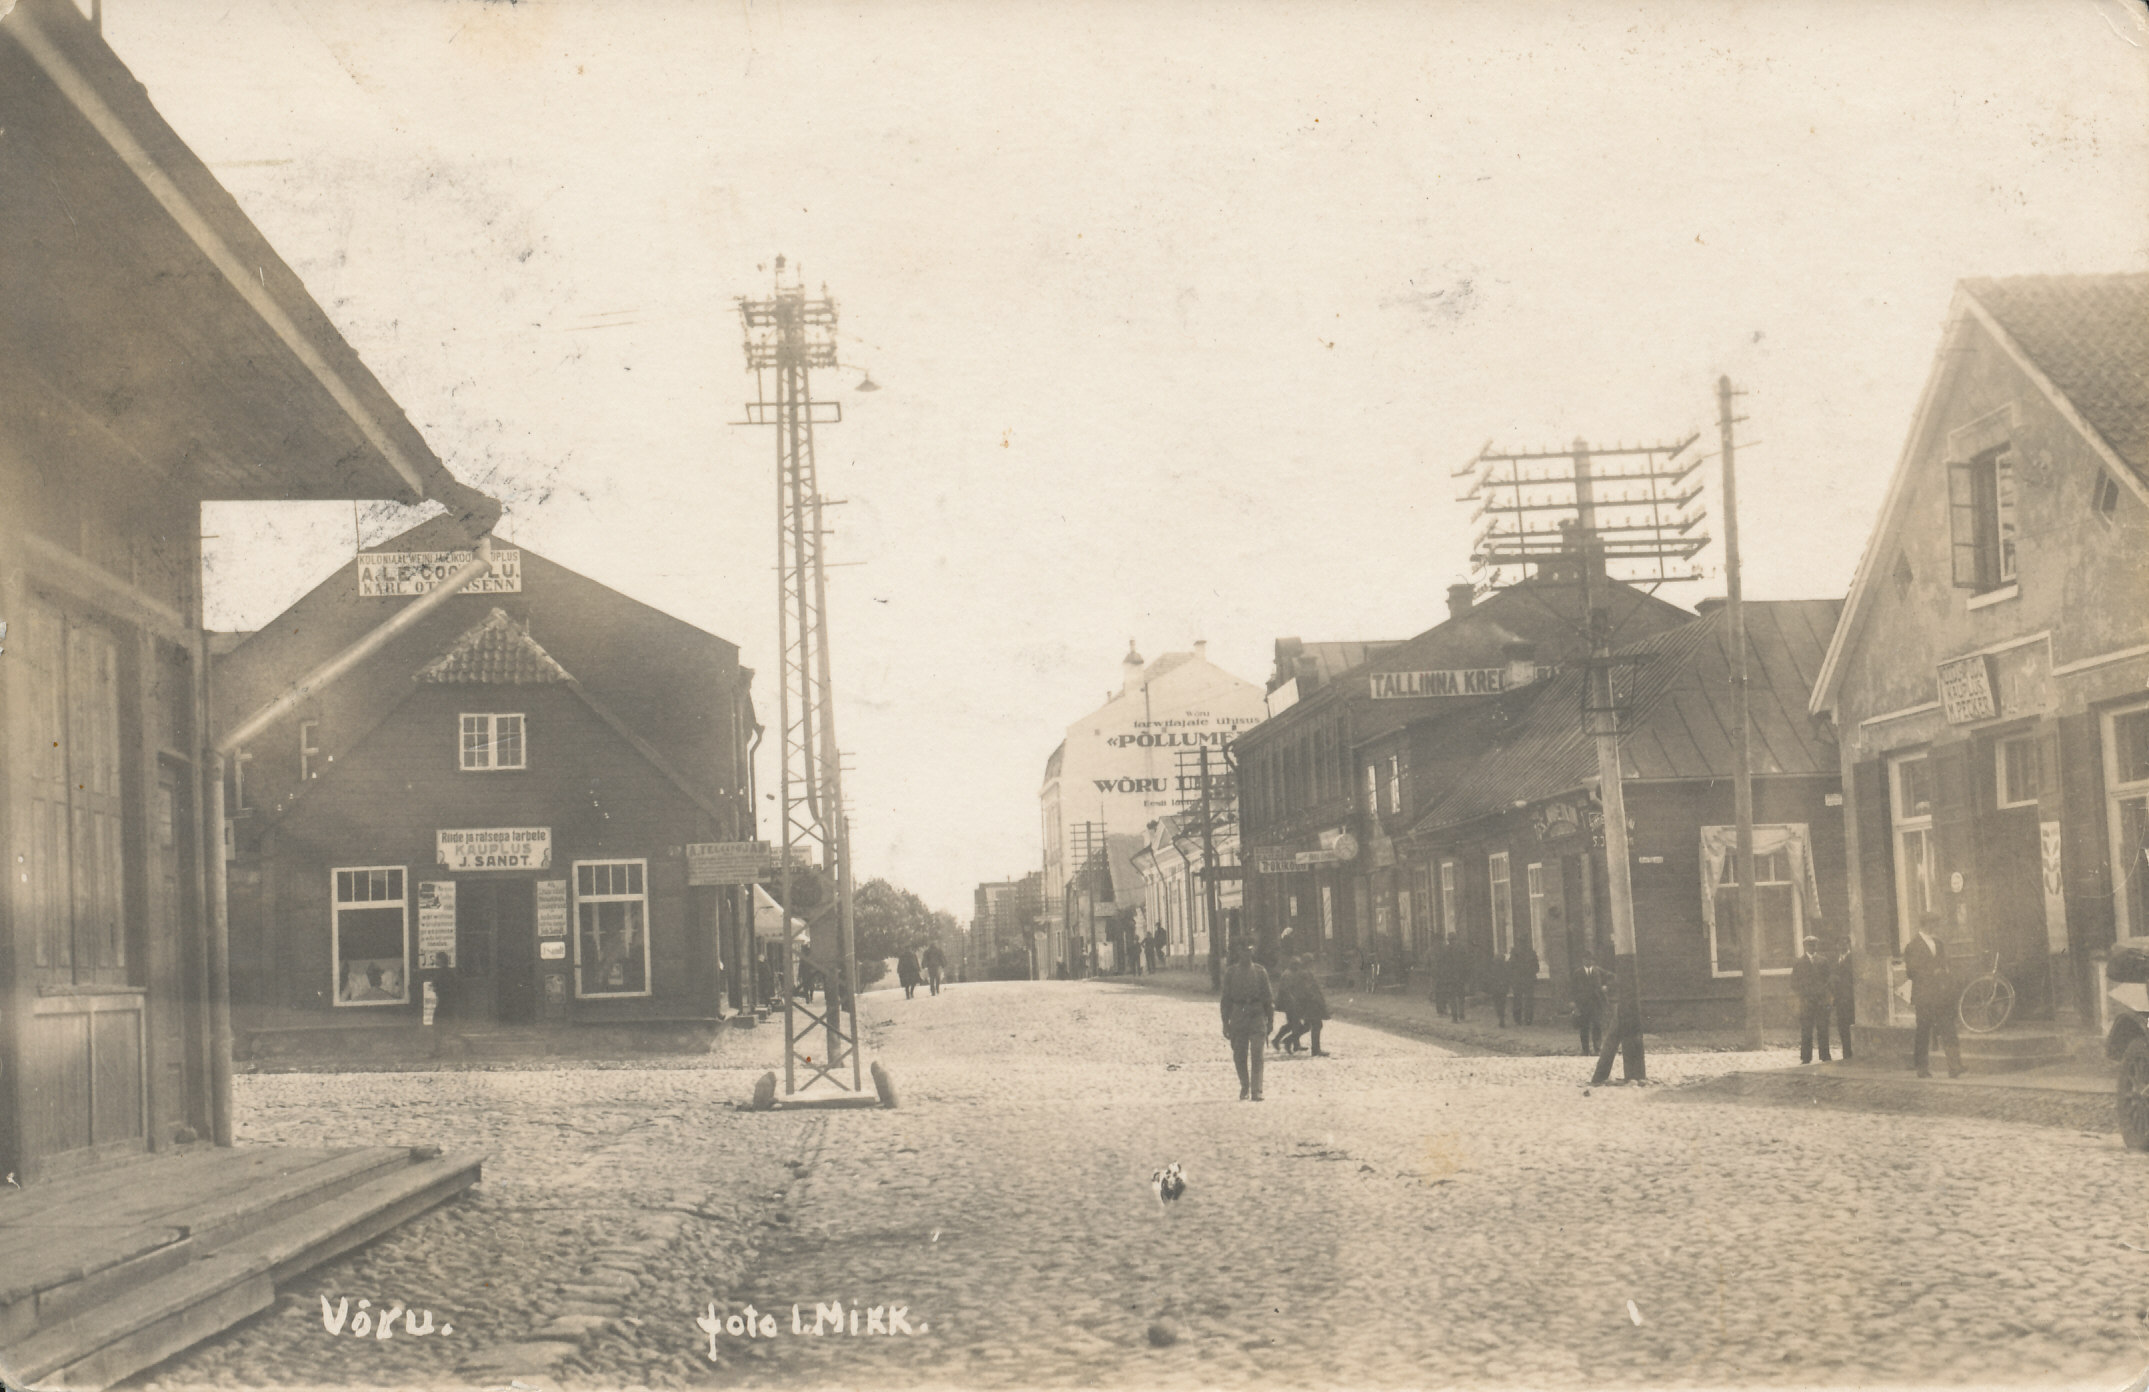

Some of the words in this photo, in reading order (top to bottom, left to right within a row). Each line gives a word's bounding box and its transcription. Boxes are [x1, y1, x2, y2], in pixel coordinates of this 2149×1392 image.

[364, 582, 407, 595] KARL
[1371, 671, 1459, 698] TALLINNA
[1093, 776, 1167, 793] WÕRU
[455, 843, 532, 856] KAUPLUS
